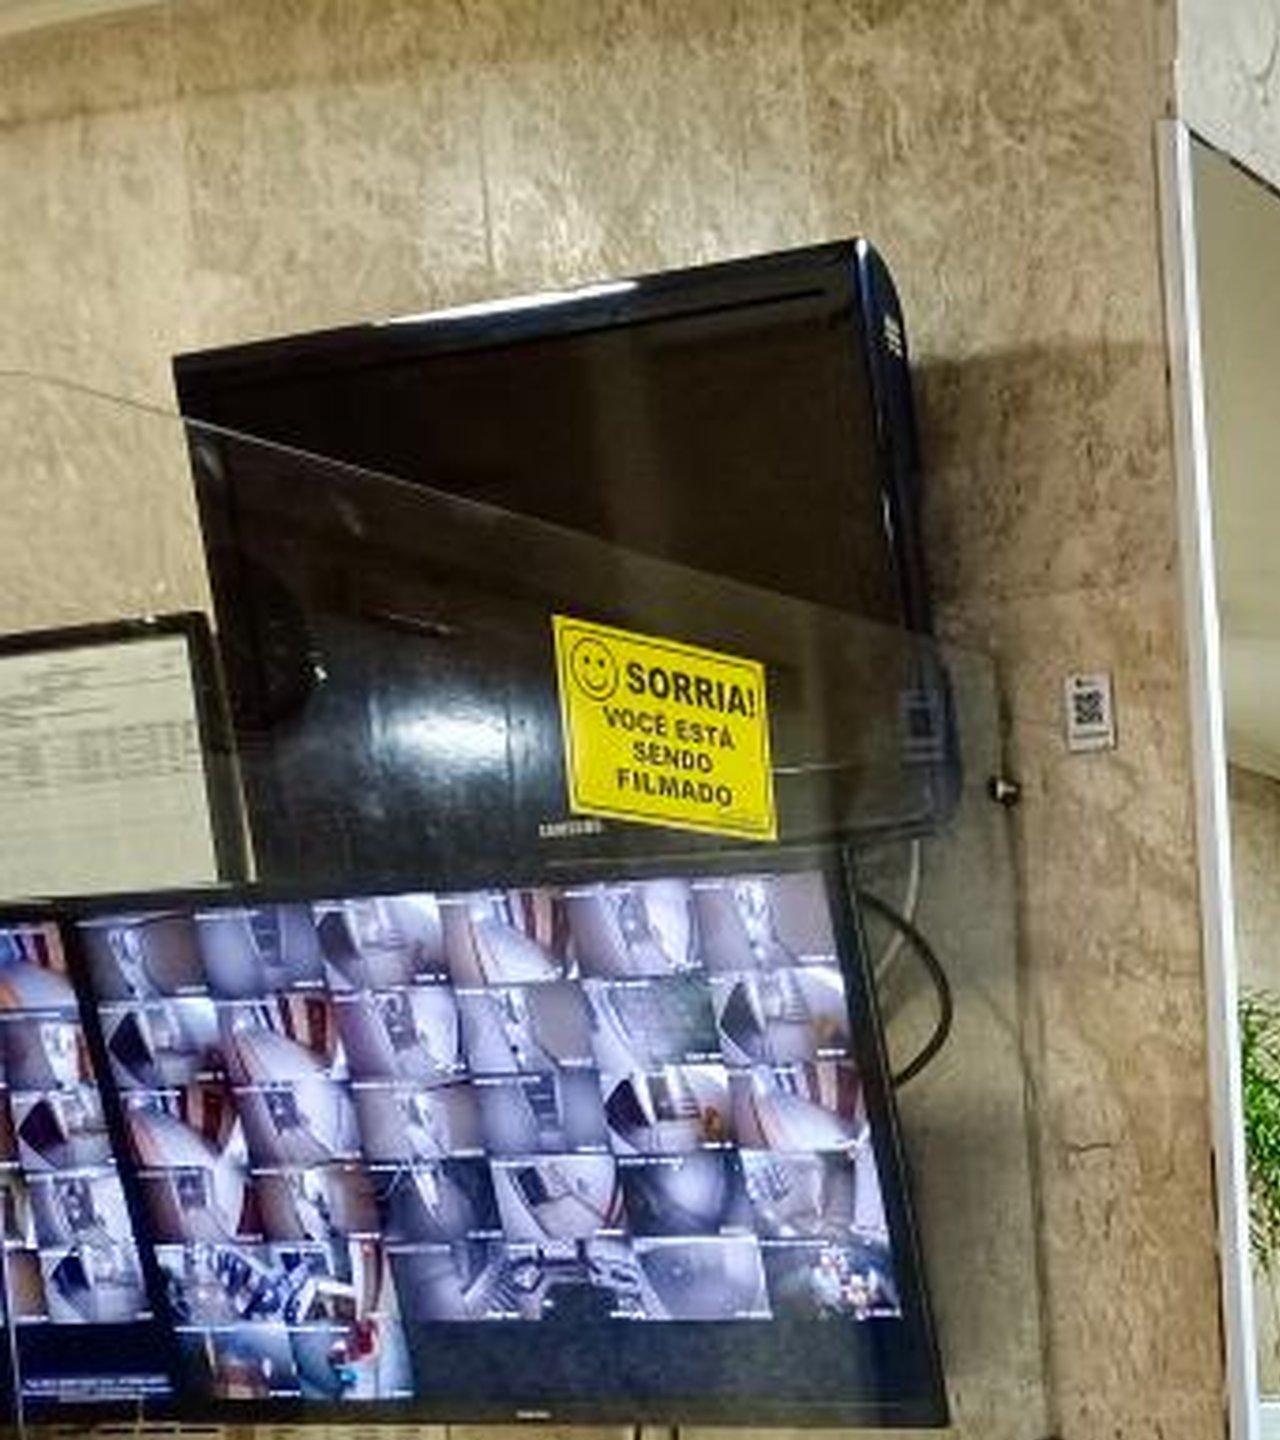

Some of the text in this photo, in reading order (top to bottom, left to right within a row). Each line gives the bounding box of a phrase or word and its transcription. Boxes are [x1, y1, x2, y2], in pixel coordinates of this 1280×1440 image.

[625, 661, 756, 719] SORRIA!
[632, 740, 714, 774] SENDO
[617, 768, 734, 808] FILMADO
